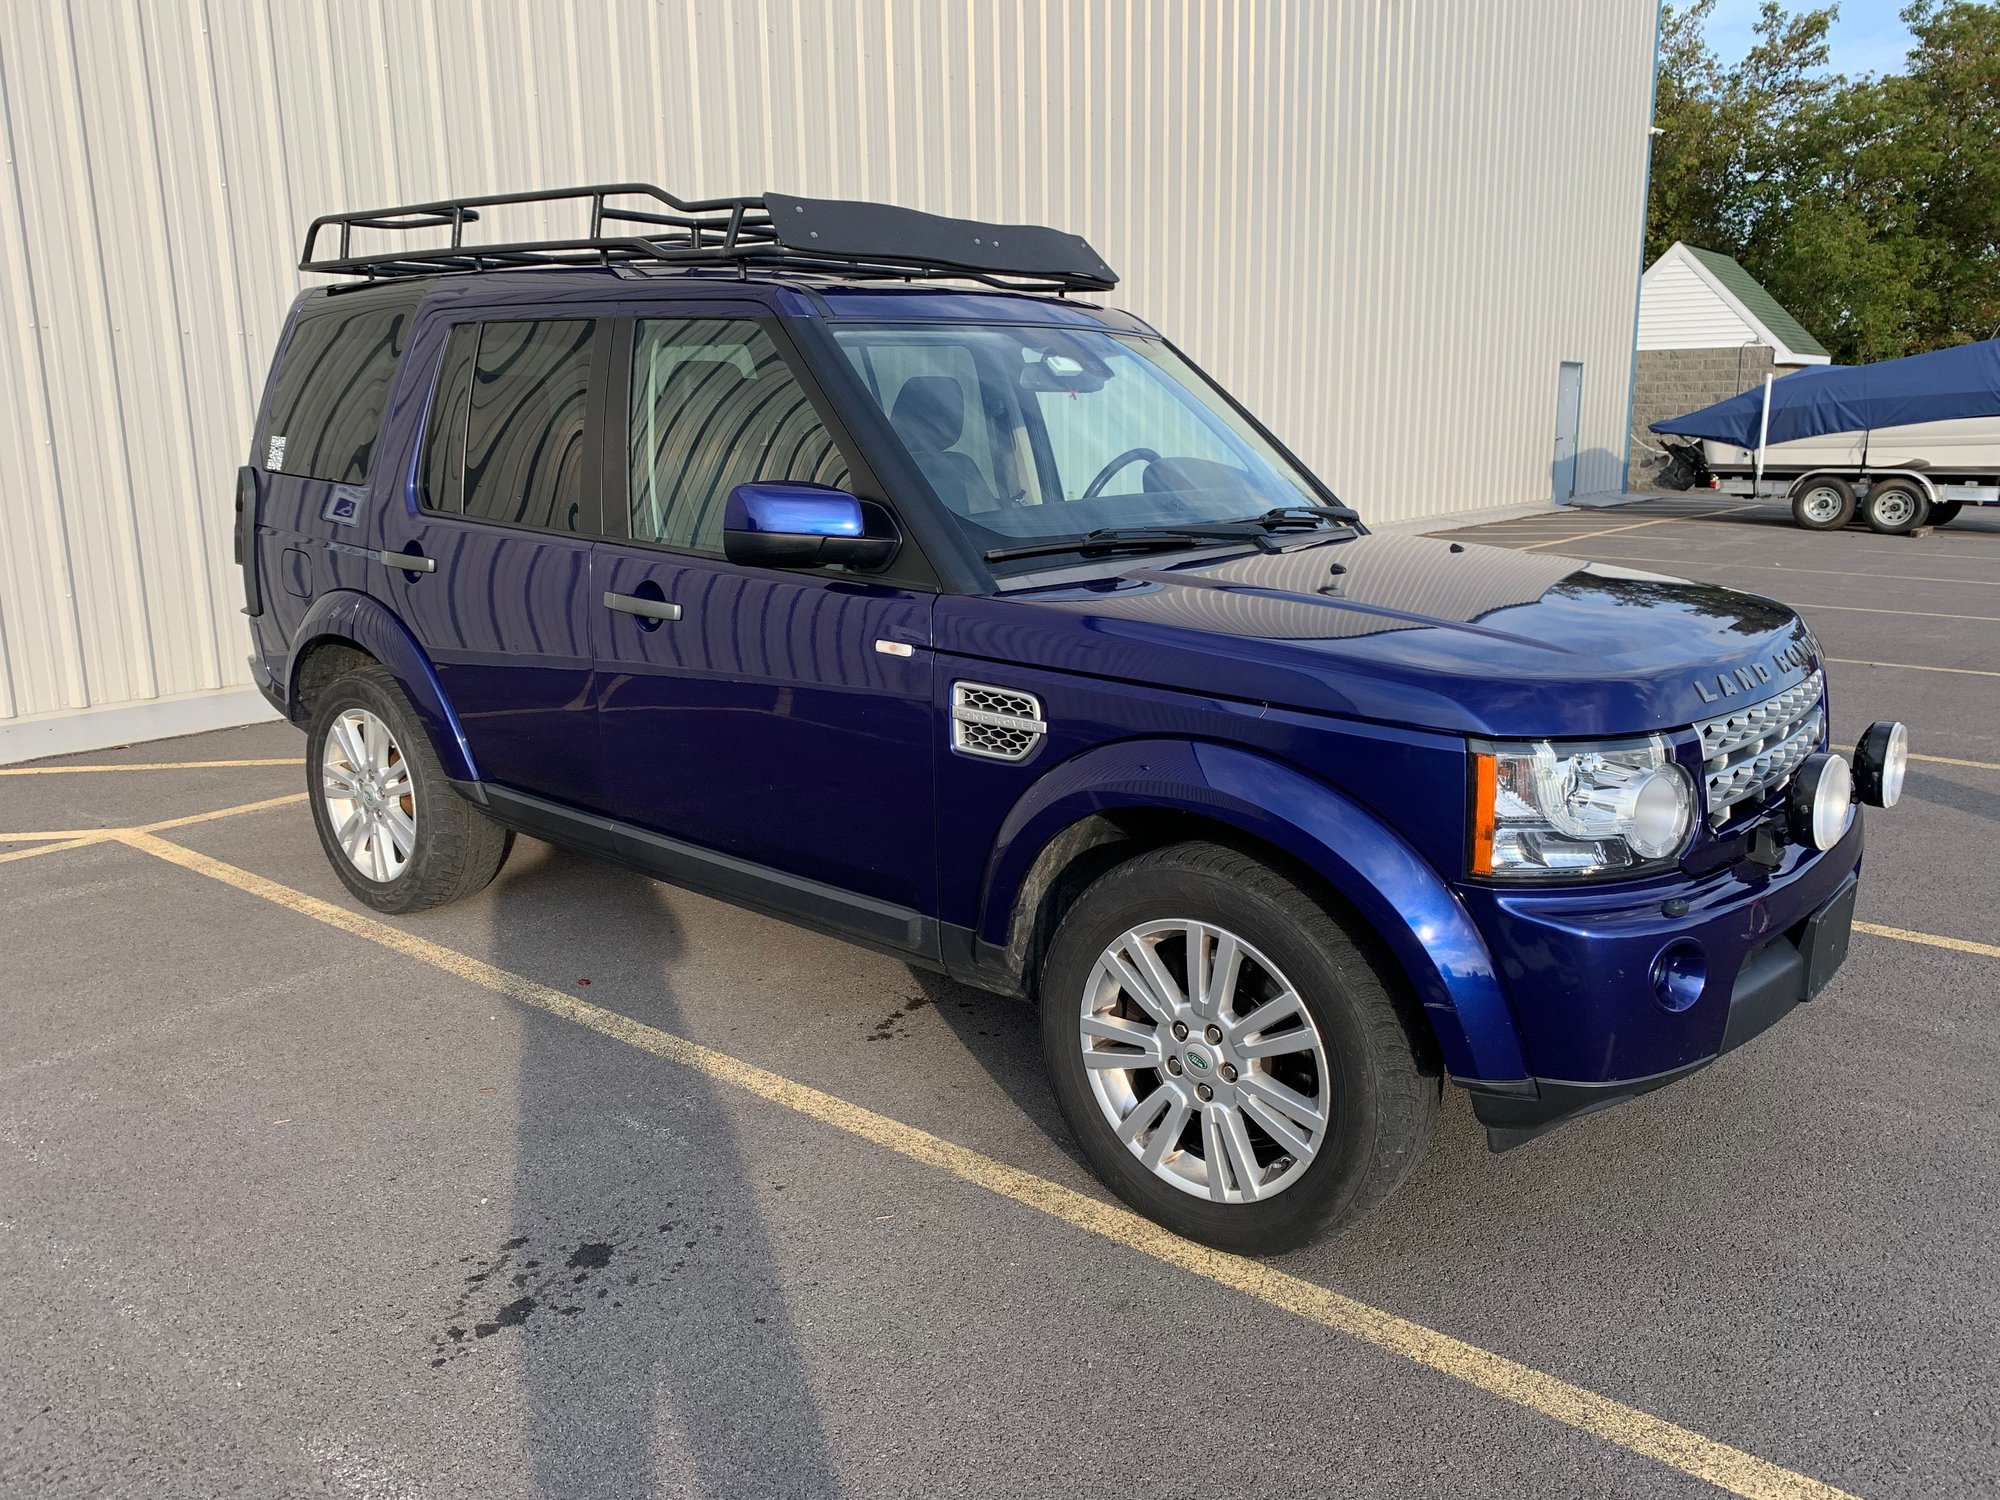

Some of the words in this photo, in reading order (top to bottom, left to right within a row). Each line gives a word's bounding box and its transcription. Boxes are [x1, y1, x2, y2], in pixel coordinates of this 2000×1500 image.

[1693, 662, 1771, 703] LAND
[955, 708, 989, 722] LAND
[994, 717, 1038, 731] ROVER
